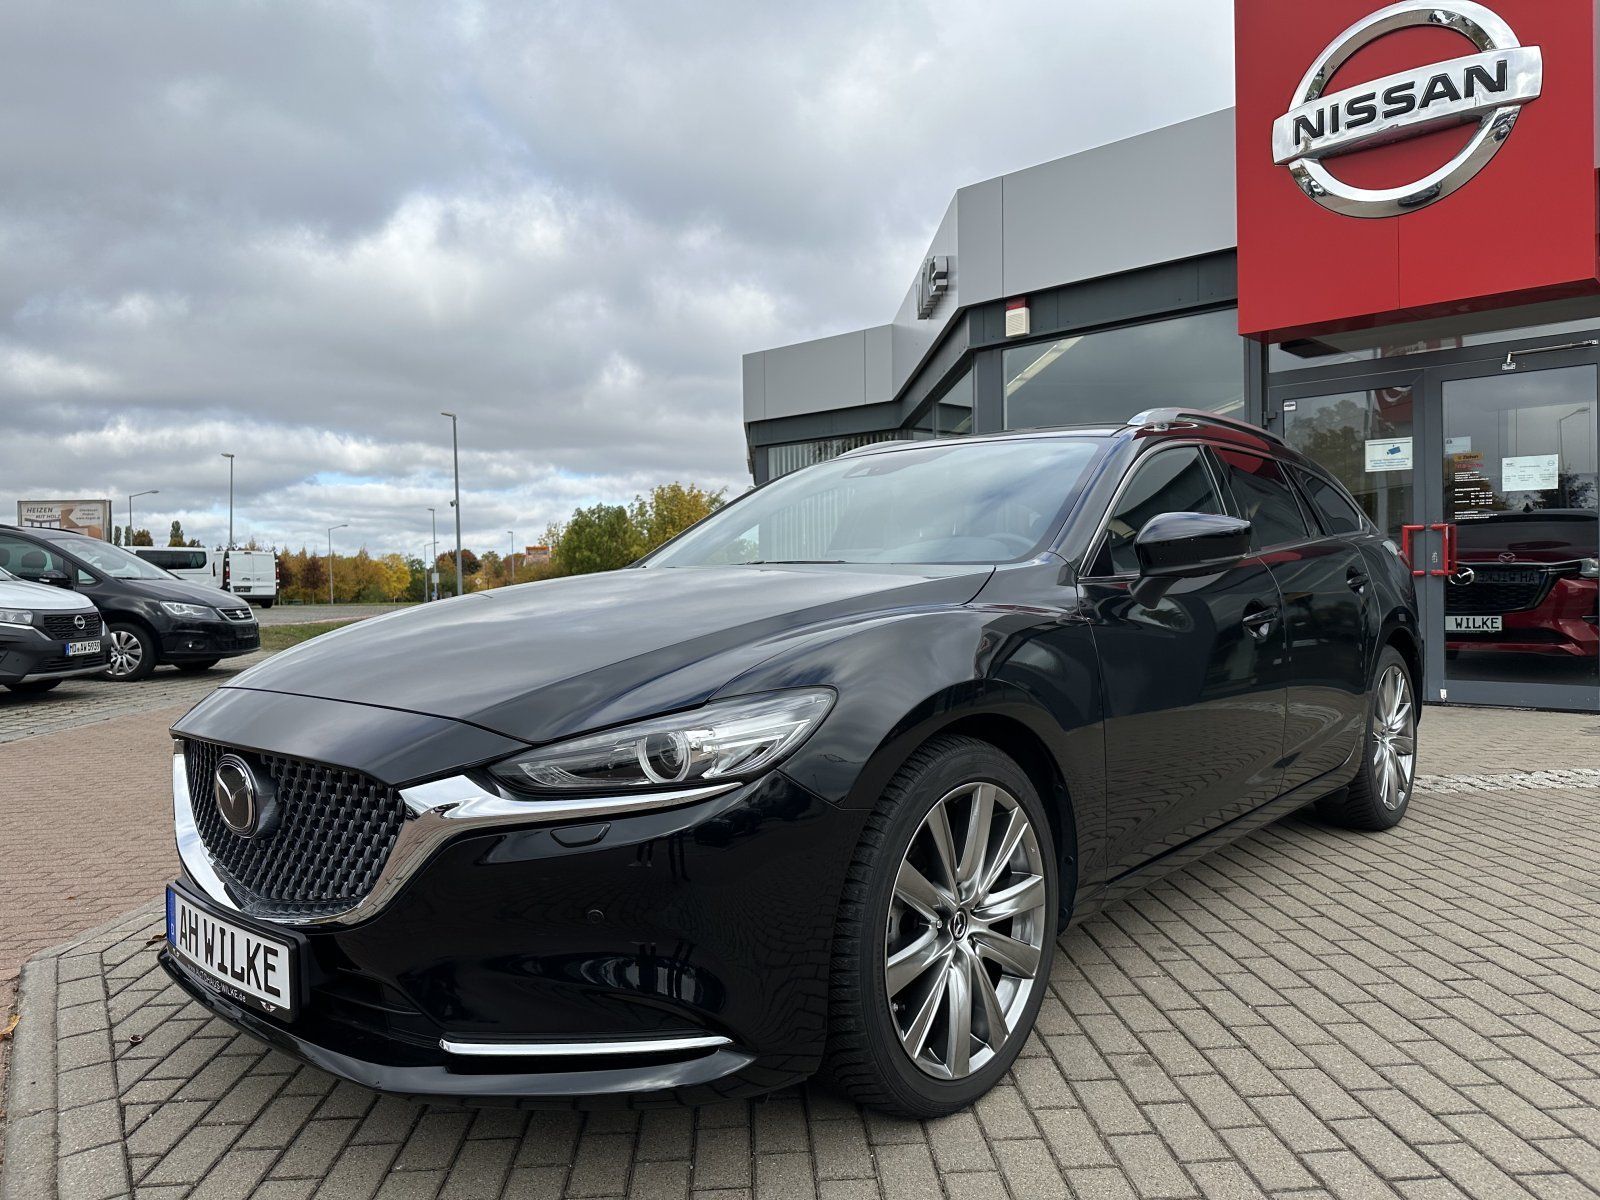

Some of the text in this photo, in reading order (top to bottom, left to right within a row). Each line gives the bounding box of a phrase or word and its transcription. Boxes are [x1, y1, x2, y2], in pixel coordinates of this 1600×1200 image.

[1293, 59, 1508, 146] NISSAN
[1454, 617, 1500, 629] WILKE
[179, 904, 199, 958] AH
[203, 918, 281, 998] WILKE
